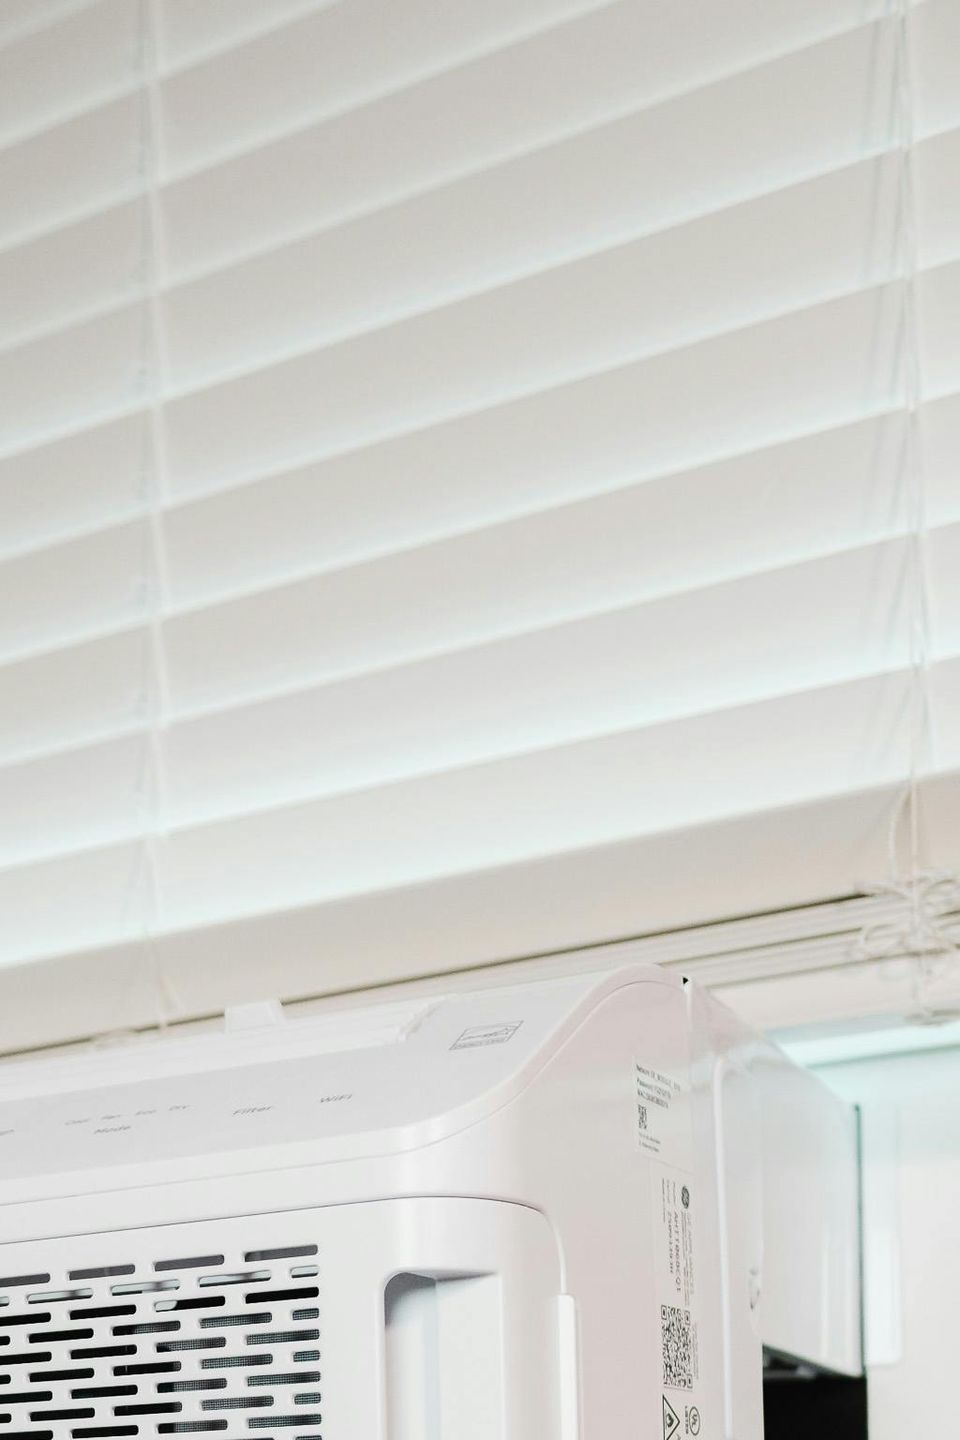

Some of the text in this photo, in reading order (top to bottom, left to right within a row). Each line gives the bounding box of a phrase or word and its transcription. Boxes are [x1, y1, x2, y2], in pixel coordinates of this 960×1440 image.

[320, 1094, 353, 1104] WiFi
[233, 1105, 273, 1115] Filter
[94, 1125, 131, 1135] Mode
